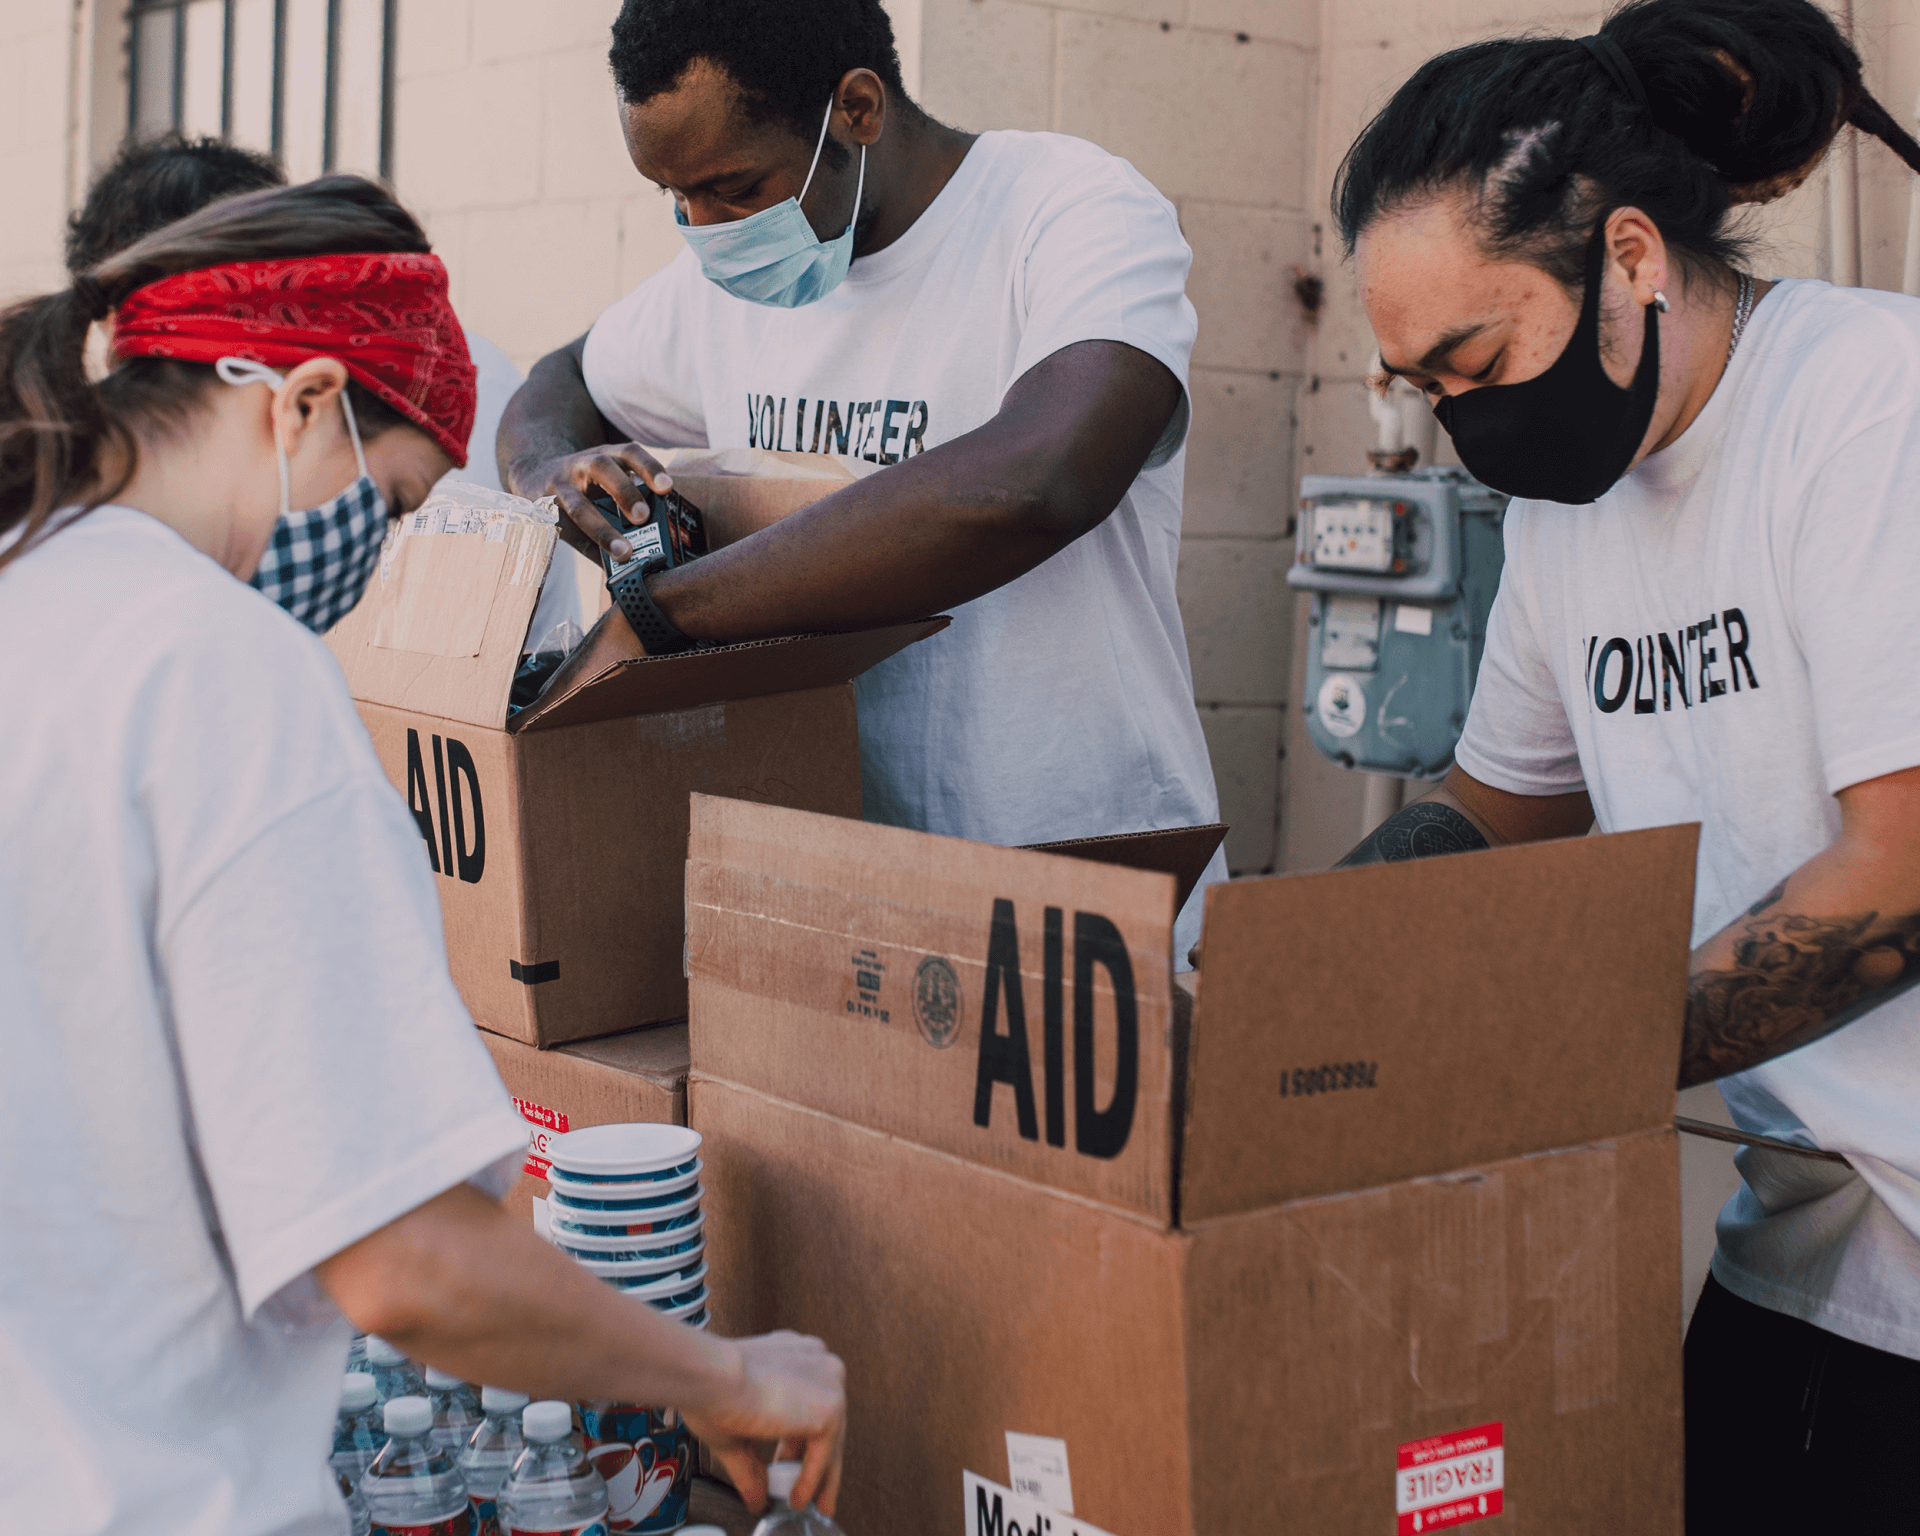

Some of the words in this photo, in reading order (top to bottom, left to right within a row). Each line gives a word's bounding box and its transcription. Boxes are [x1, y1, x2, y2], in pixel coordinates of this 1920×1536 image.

[747, 393, 929, 466] VOLUNTEER
[407, 727, 485, 884] AID
[973, 896, 1139, 1161] AID
[1406, 1457, 1493, 1502] FRAGILE
